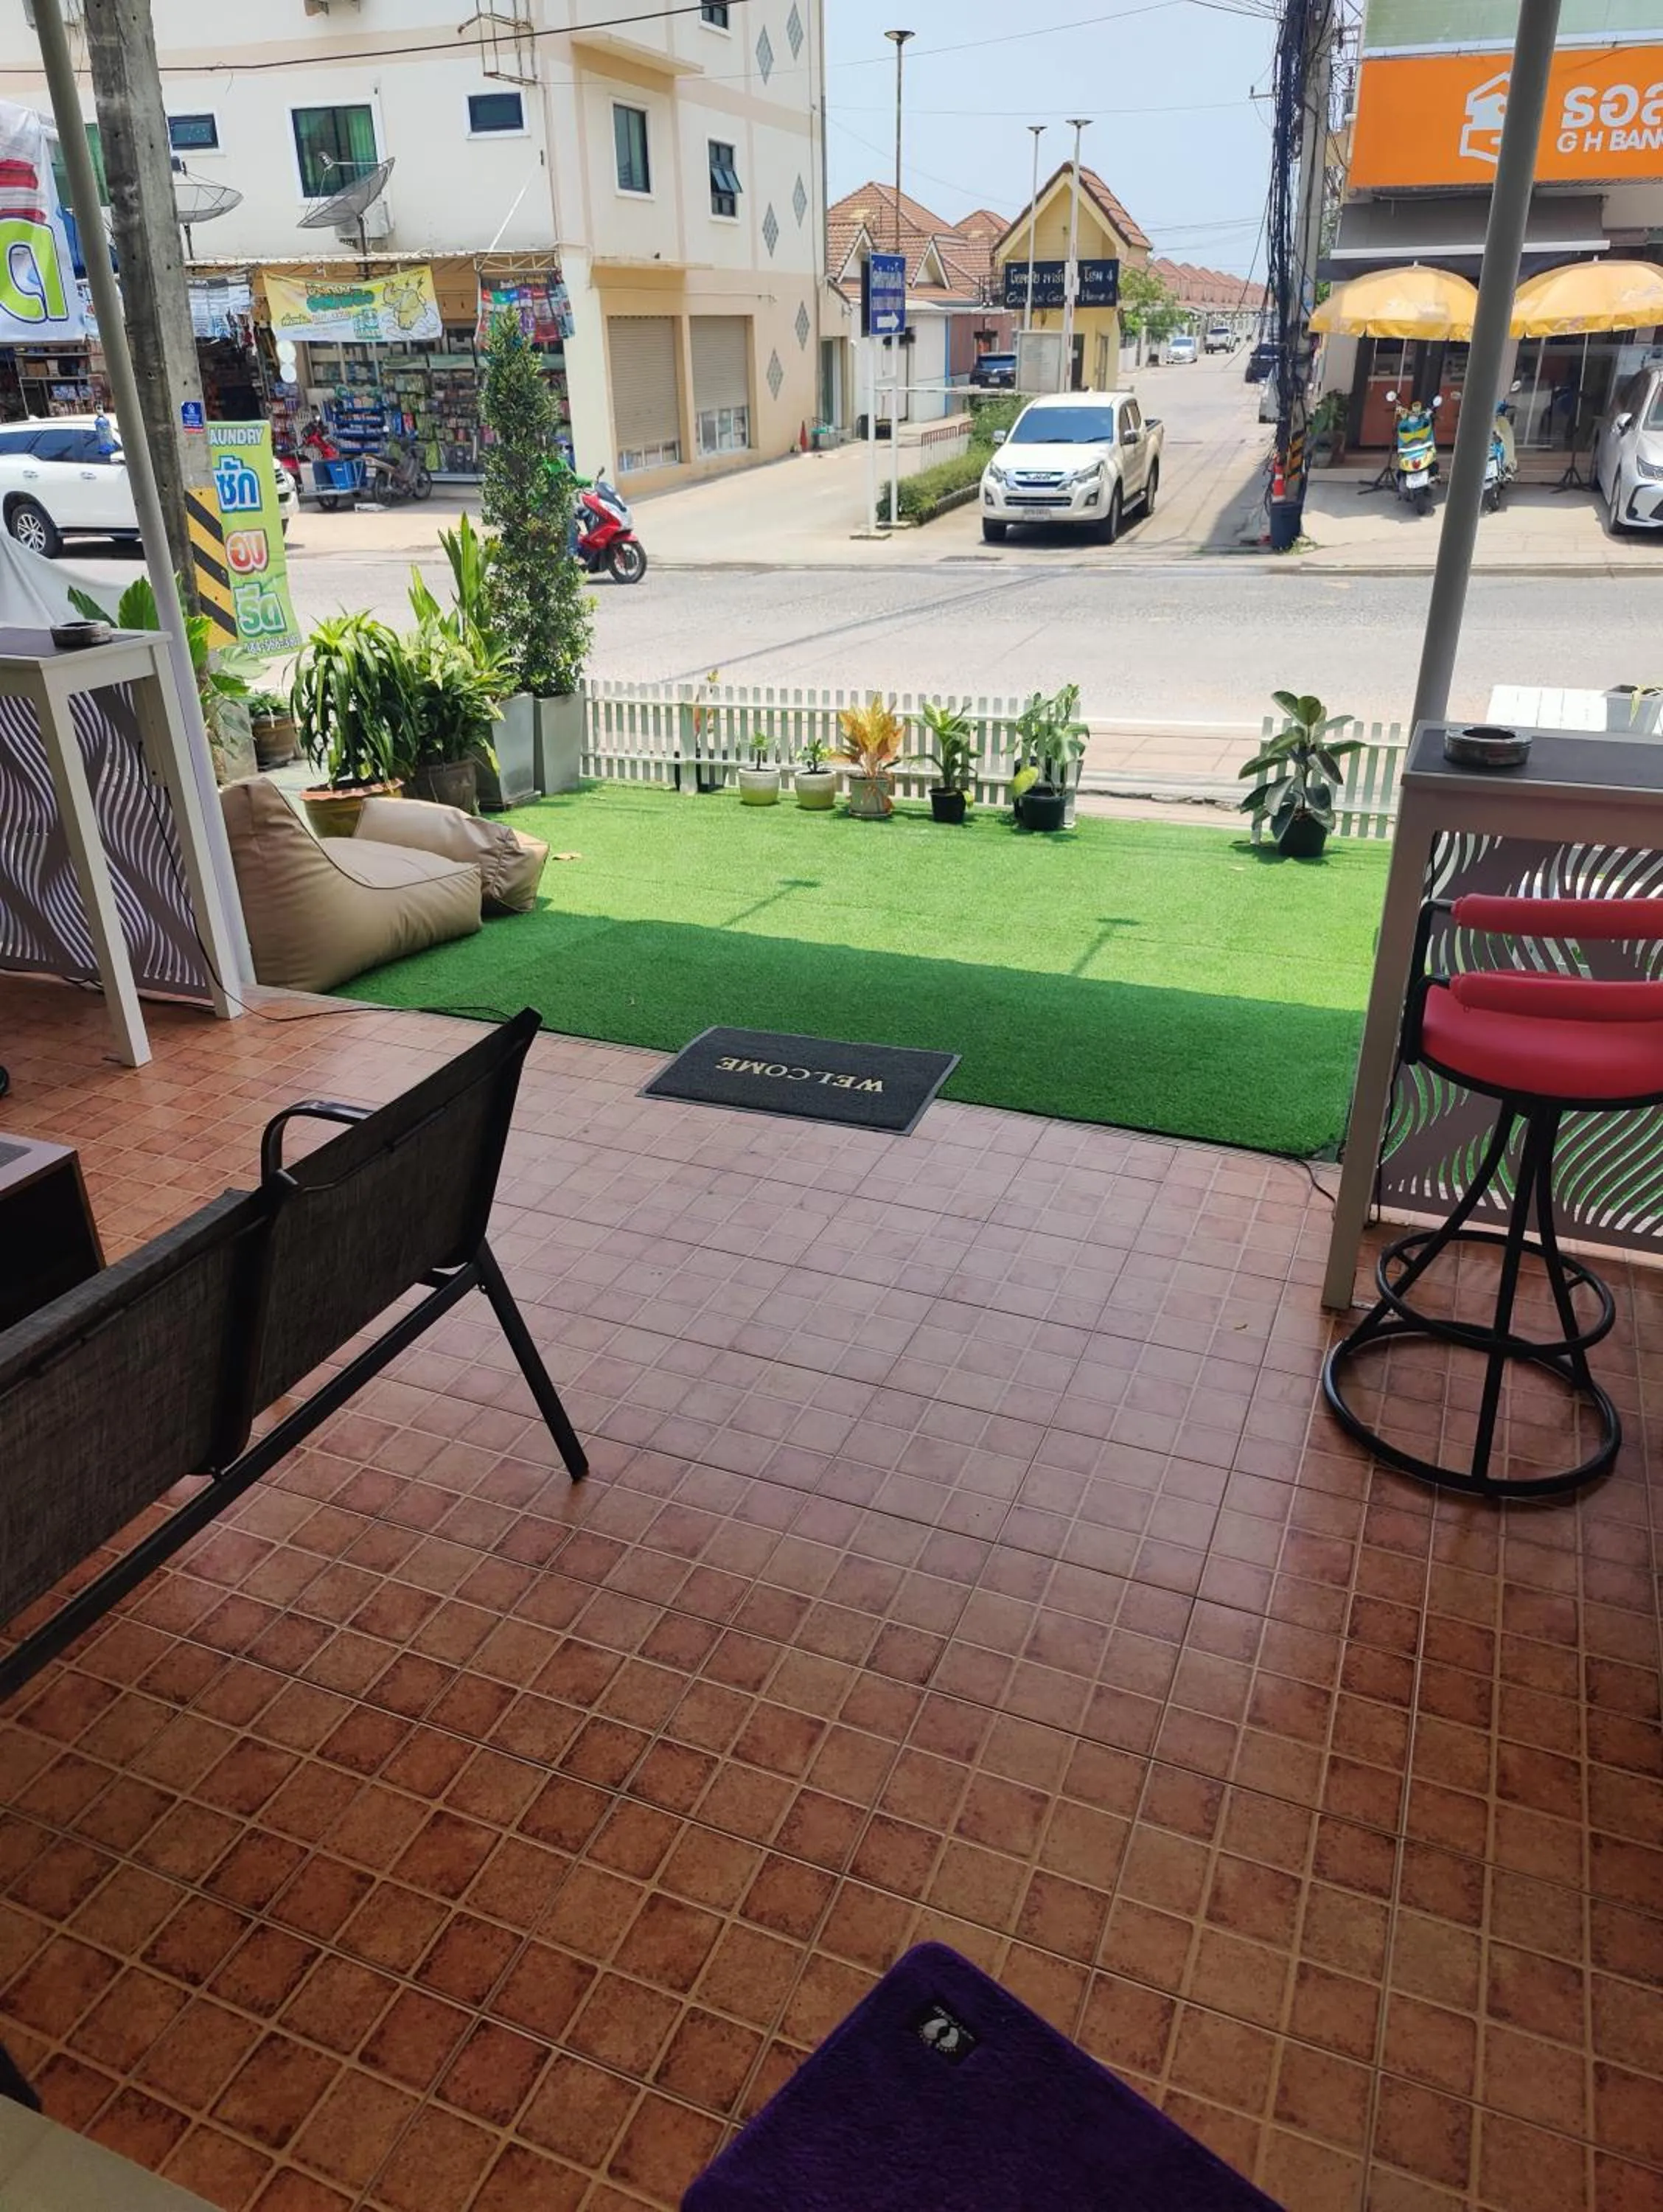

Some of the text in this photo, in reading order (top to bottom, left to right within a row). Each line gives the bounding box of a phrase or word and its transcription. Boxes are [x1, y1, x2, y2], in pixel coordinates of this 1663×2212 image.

[1608, 128, 1663, 151] BAN
[209, 428, 263, 445] AUNDRY
[715, 1057, 884, 1092] WELCOME
